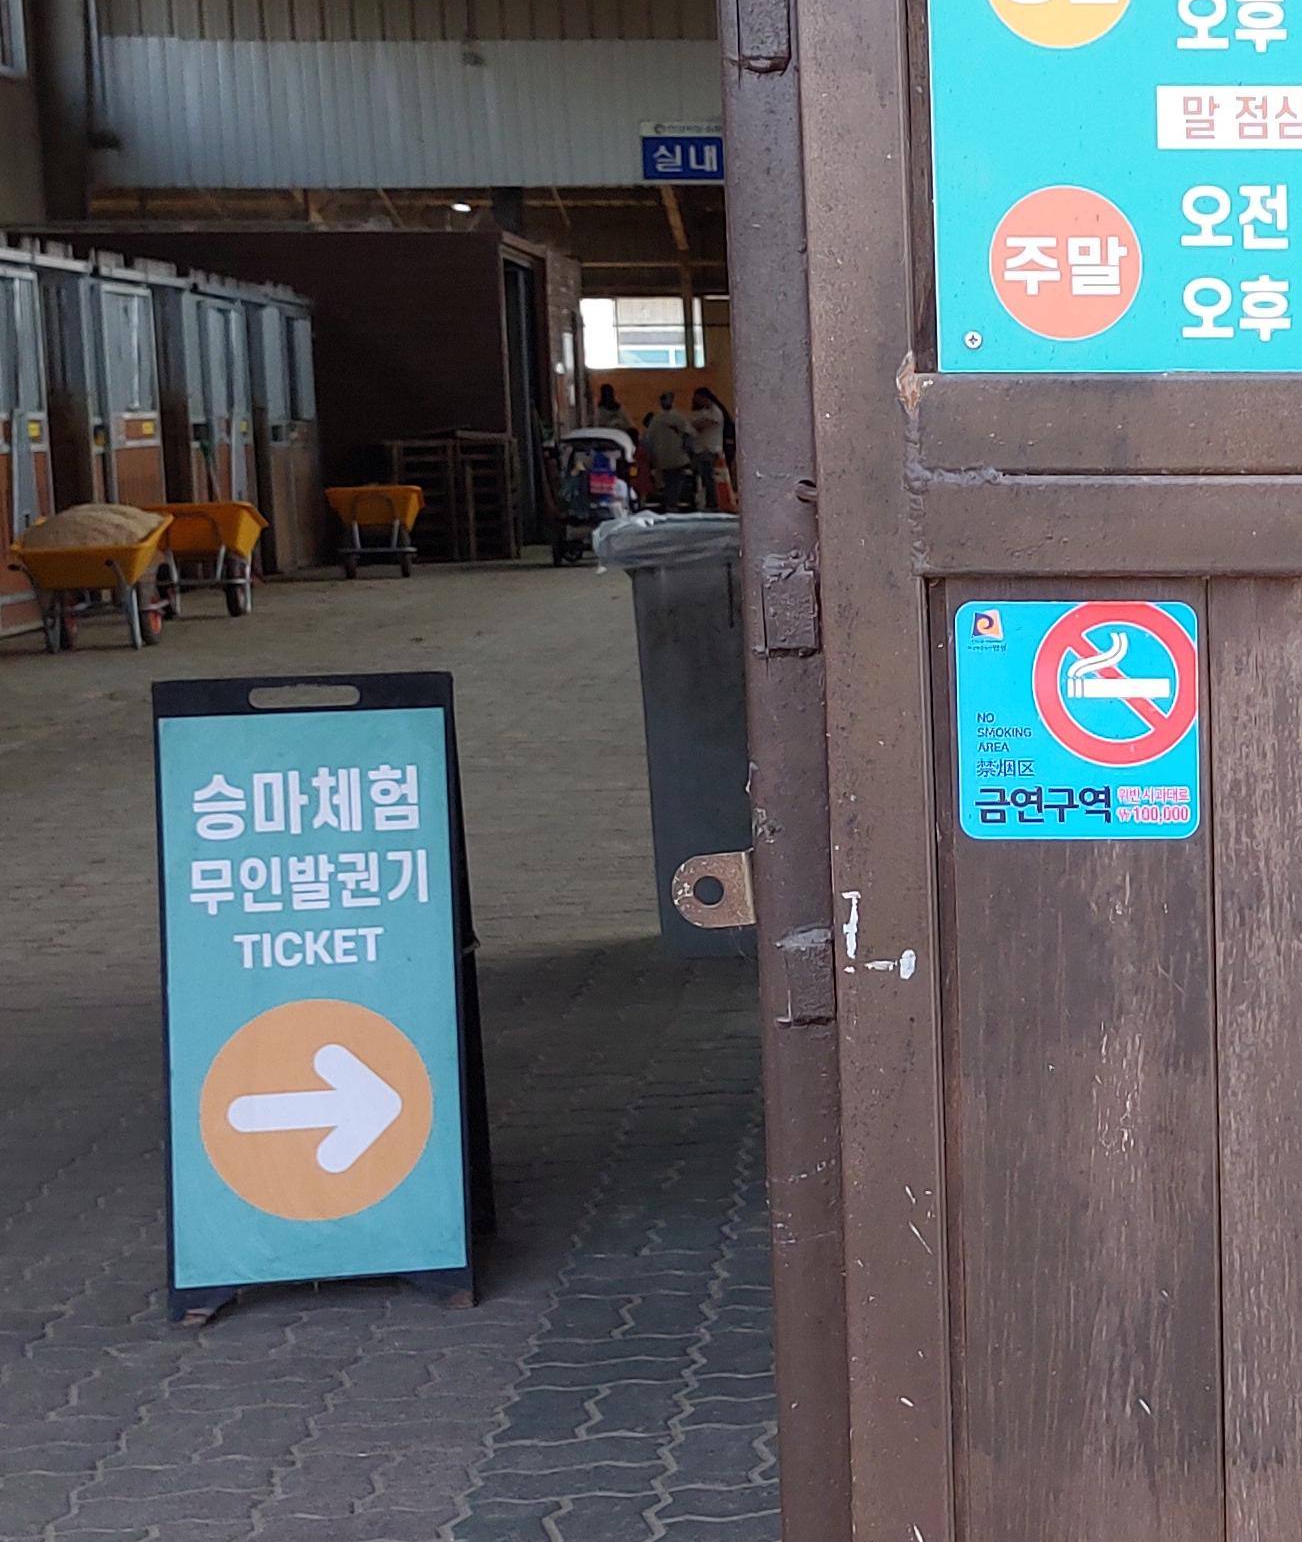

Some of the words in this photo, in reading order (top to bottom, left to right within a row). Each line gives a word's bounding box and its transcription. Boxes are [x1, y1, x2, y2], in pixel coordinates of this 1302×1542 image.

[1181, 96, 1221, 140] 말
[652, 145, 717, 172] 실내
[1179, 183, 1291, 251] 오전
[1001, 235, 1129, 297] 주말
[1180, 273, 1293, 343] 오후
[977, 713, 994, 723] NO
[977, 727, 1032, 738] SMOKING
[978, 742, 1009, 752] AREA
[976, 759, 1035, 778] 禁烟区
[192, 764, 421, 842] 승마체험
[975, 786, 1111, 823] 금연구역
[189, 849, 429, 916] 무인발권기
[233, 927, 384, 969] TICKET
